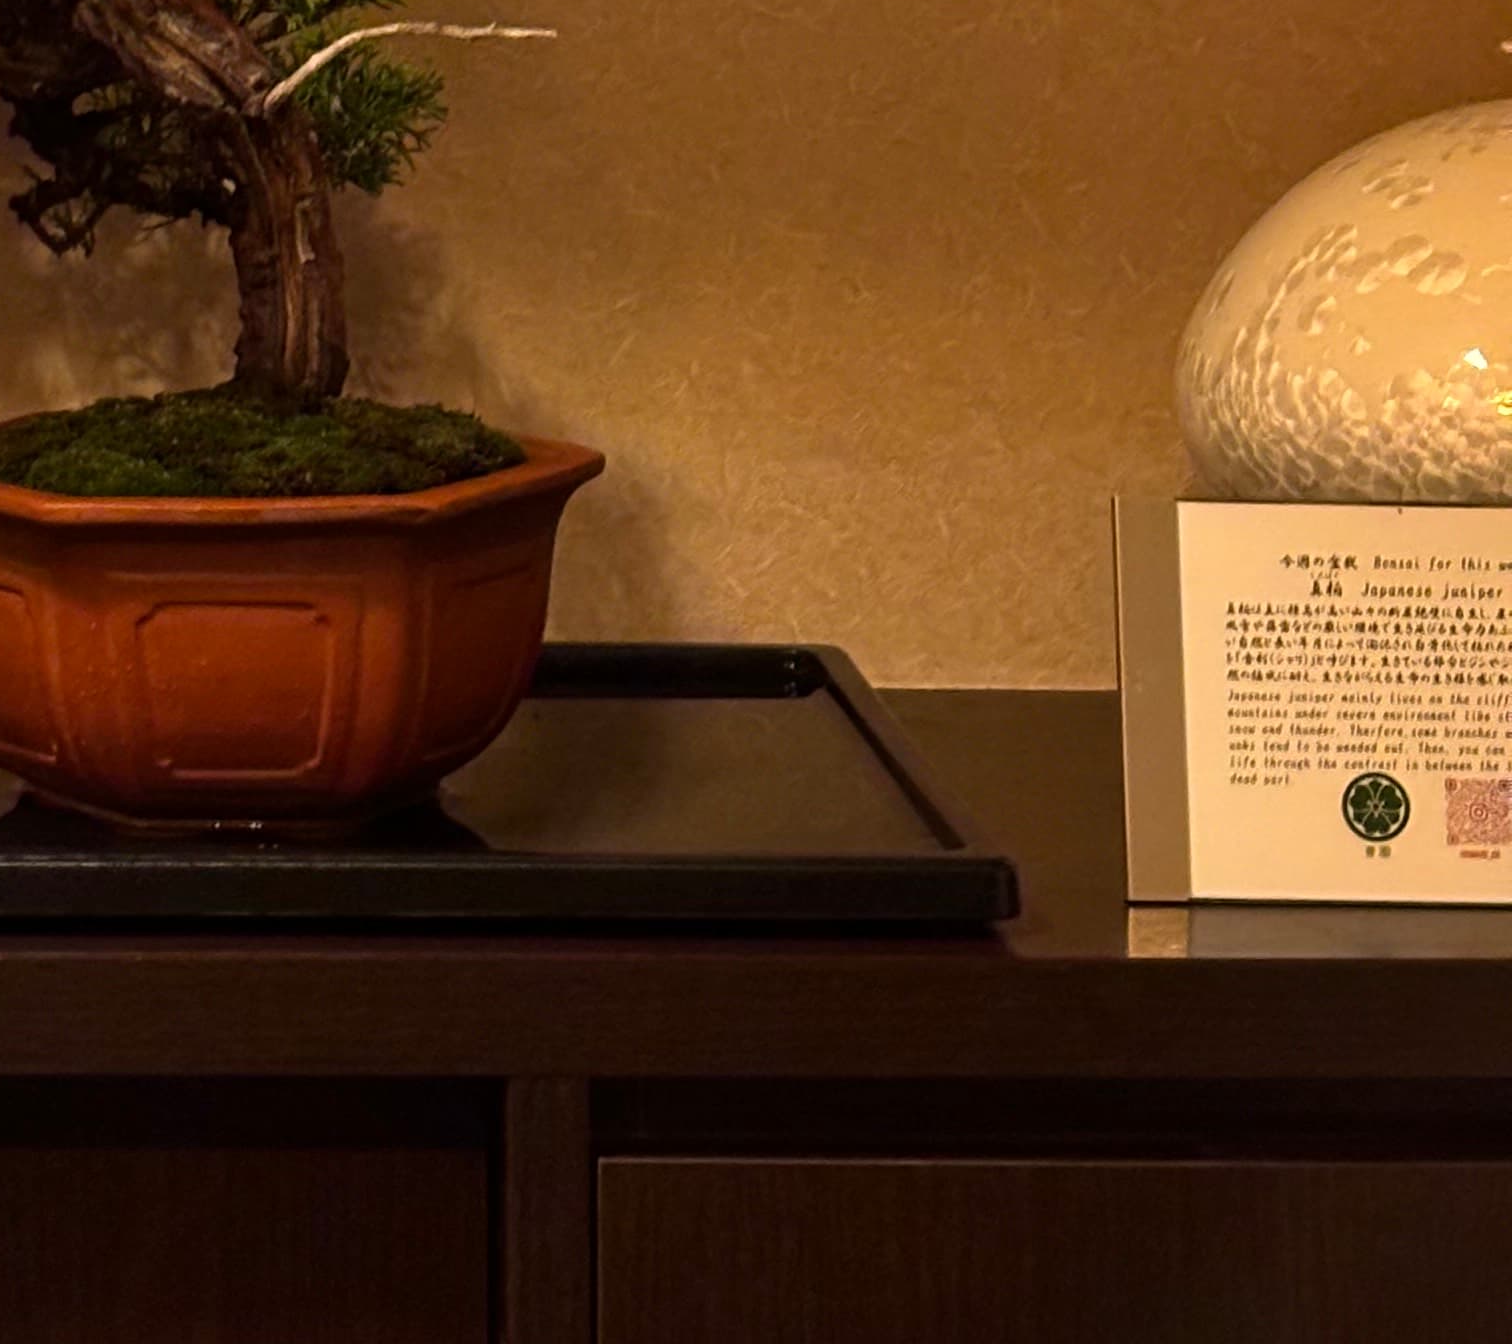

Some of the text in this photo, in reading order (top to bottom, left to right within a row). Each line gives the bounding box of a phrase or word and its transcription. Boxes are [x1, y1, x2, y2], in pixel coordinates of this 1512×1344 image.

[1374, 555, 1419, 570] Bonsai
[1429, 556, 1452, 572] for
[1461, 557, 1490, 572] this
[1361, 582, 1432, 599] Japanese
[1442, 582, 1503, 601] juniper
[1228, 689, 1281, 702] Japanese
[1288, 691, 1334, 704] juniper
[1341, 692, 1382, 705] mainly
[1390, 691, 1422, 705] lives
[1429, 696, 1442, 704] on
[1450, 693, 1469, 705] the
[1227, 707, 1288, 718] mountains
[1295, 707, 1328, 720] under
[1383, 710, 1455, 722] environment
[1465, 710, 1490, 722] like
[1229, 725, 1255, 734] snow
[1262, 723, 1283, 735] and
[1412, 727, 1437, 738] some
[1444, 726, 1497, 739] branches
[1264, 740, 1290, 752] tend
[1297, 740, 1309, 752] to
[1316, 741, 1330, 753] be
[1459, 746, 1479, 756] you
[1230, 755, 1256, 769] life
[1264, 756, 1310, 771] through
[1318, 757, 1337, 769] the
[1344, 759, 1397, 772] contrast
[1406, 760, 1418, 771] in
[1425, 759, 1472, 771] between
[1480, 760, 1499, 771] the
[1230, 773, 1257, 785] dead
